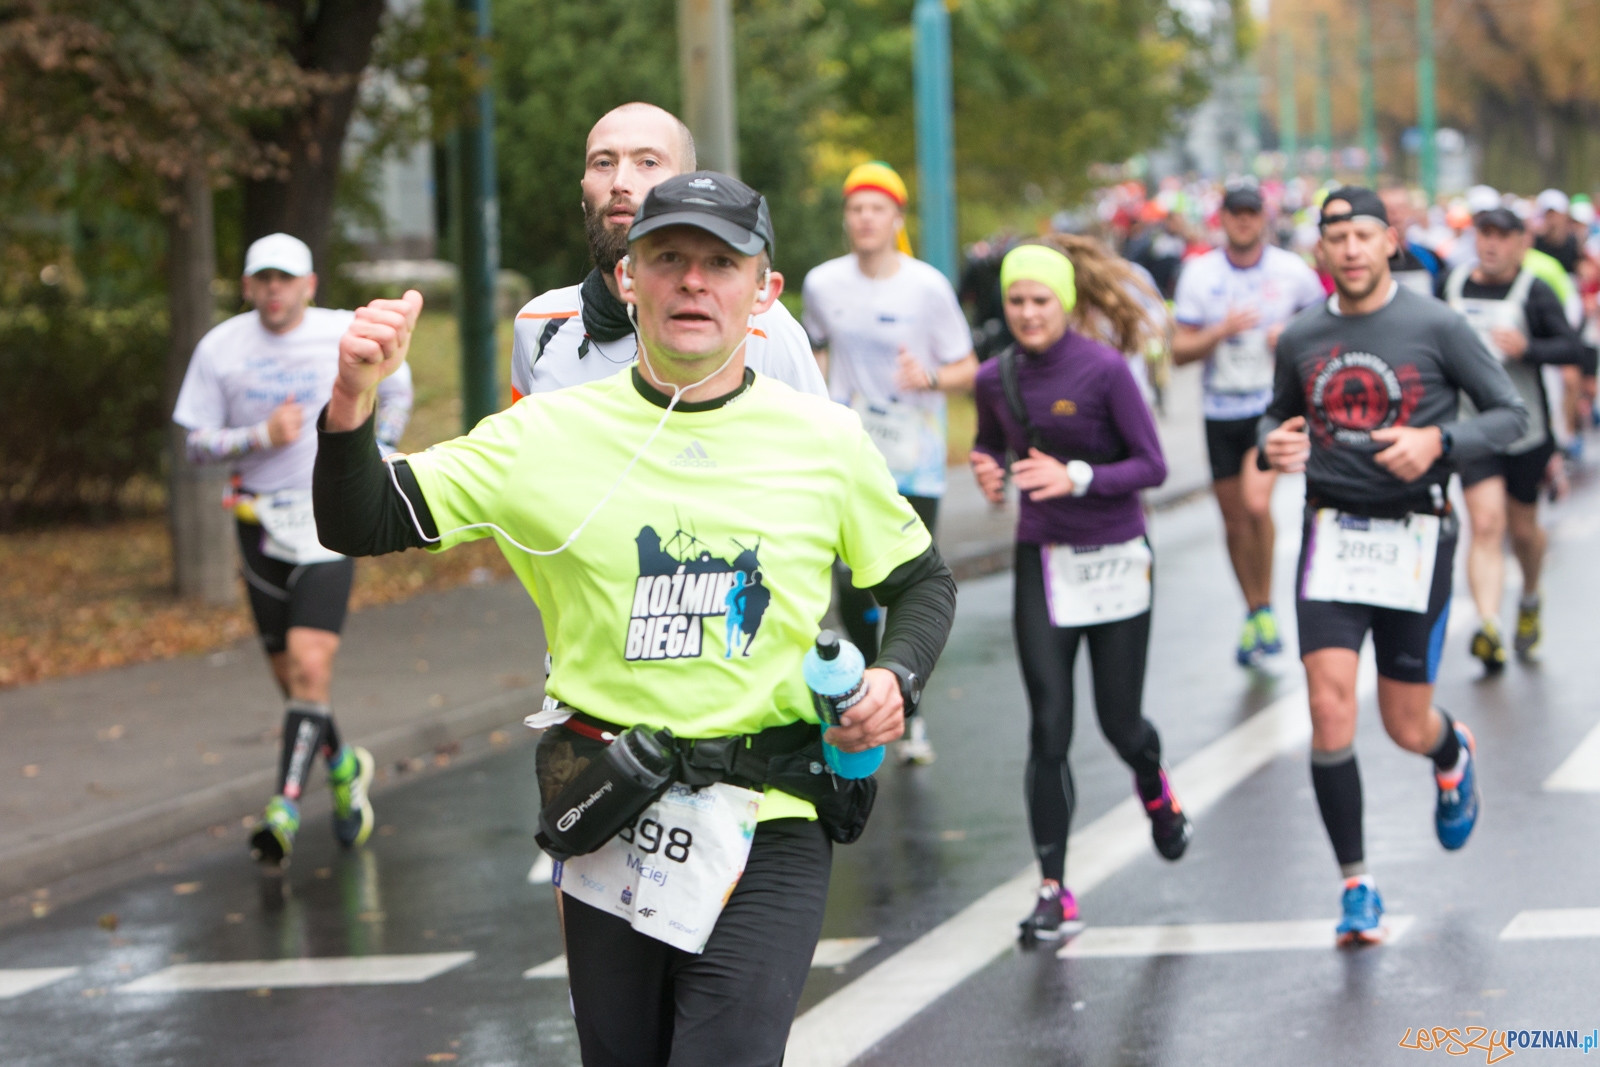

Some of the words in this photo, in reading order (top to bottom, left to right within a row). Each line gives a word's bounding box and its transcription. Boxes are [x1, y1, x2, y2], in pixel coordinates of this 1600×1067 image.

[669, 458, 717, 468] adidas
[631, 565, 735, 617] KOŹMIN
[625, 615, 701, 660] BIEGA
